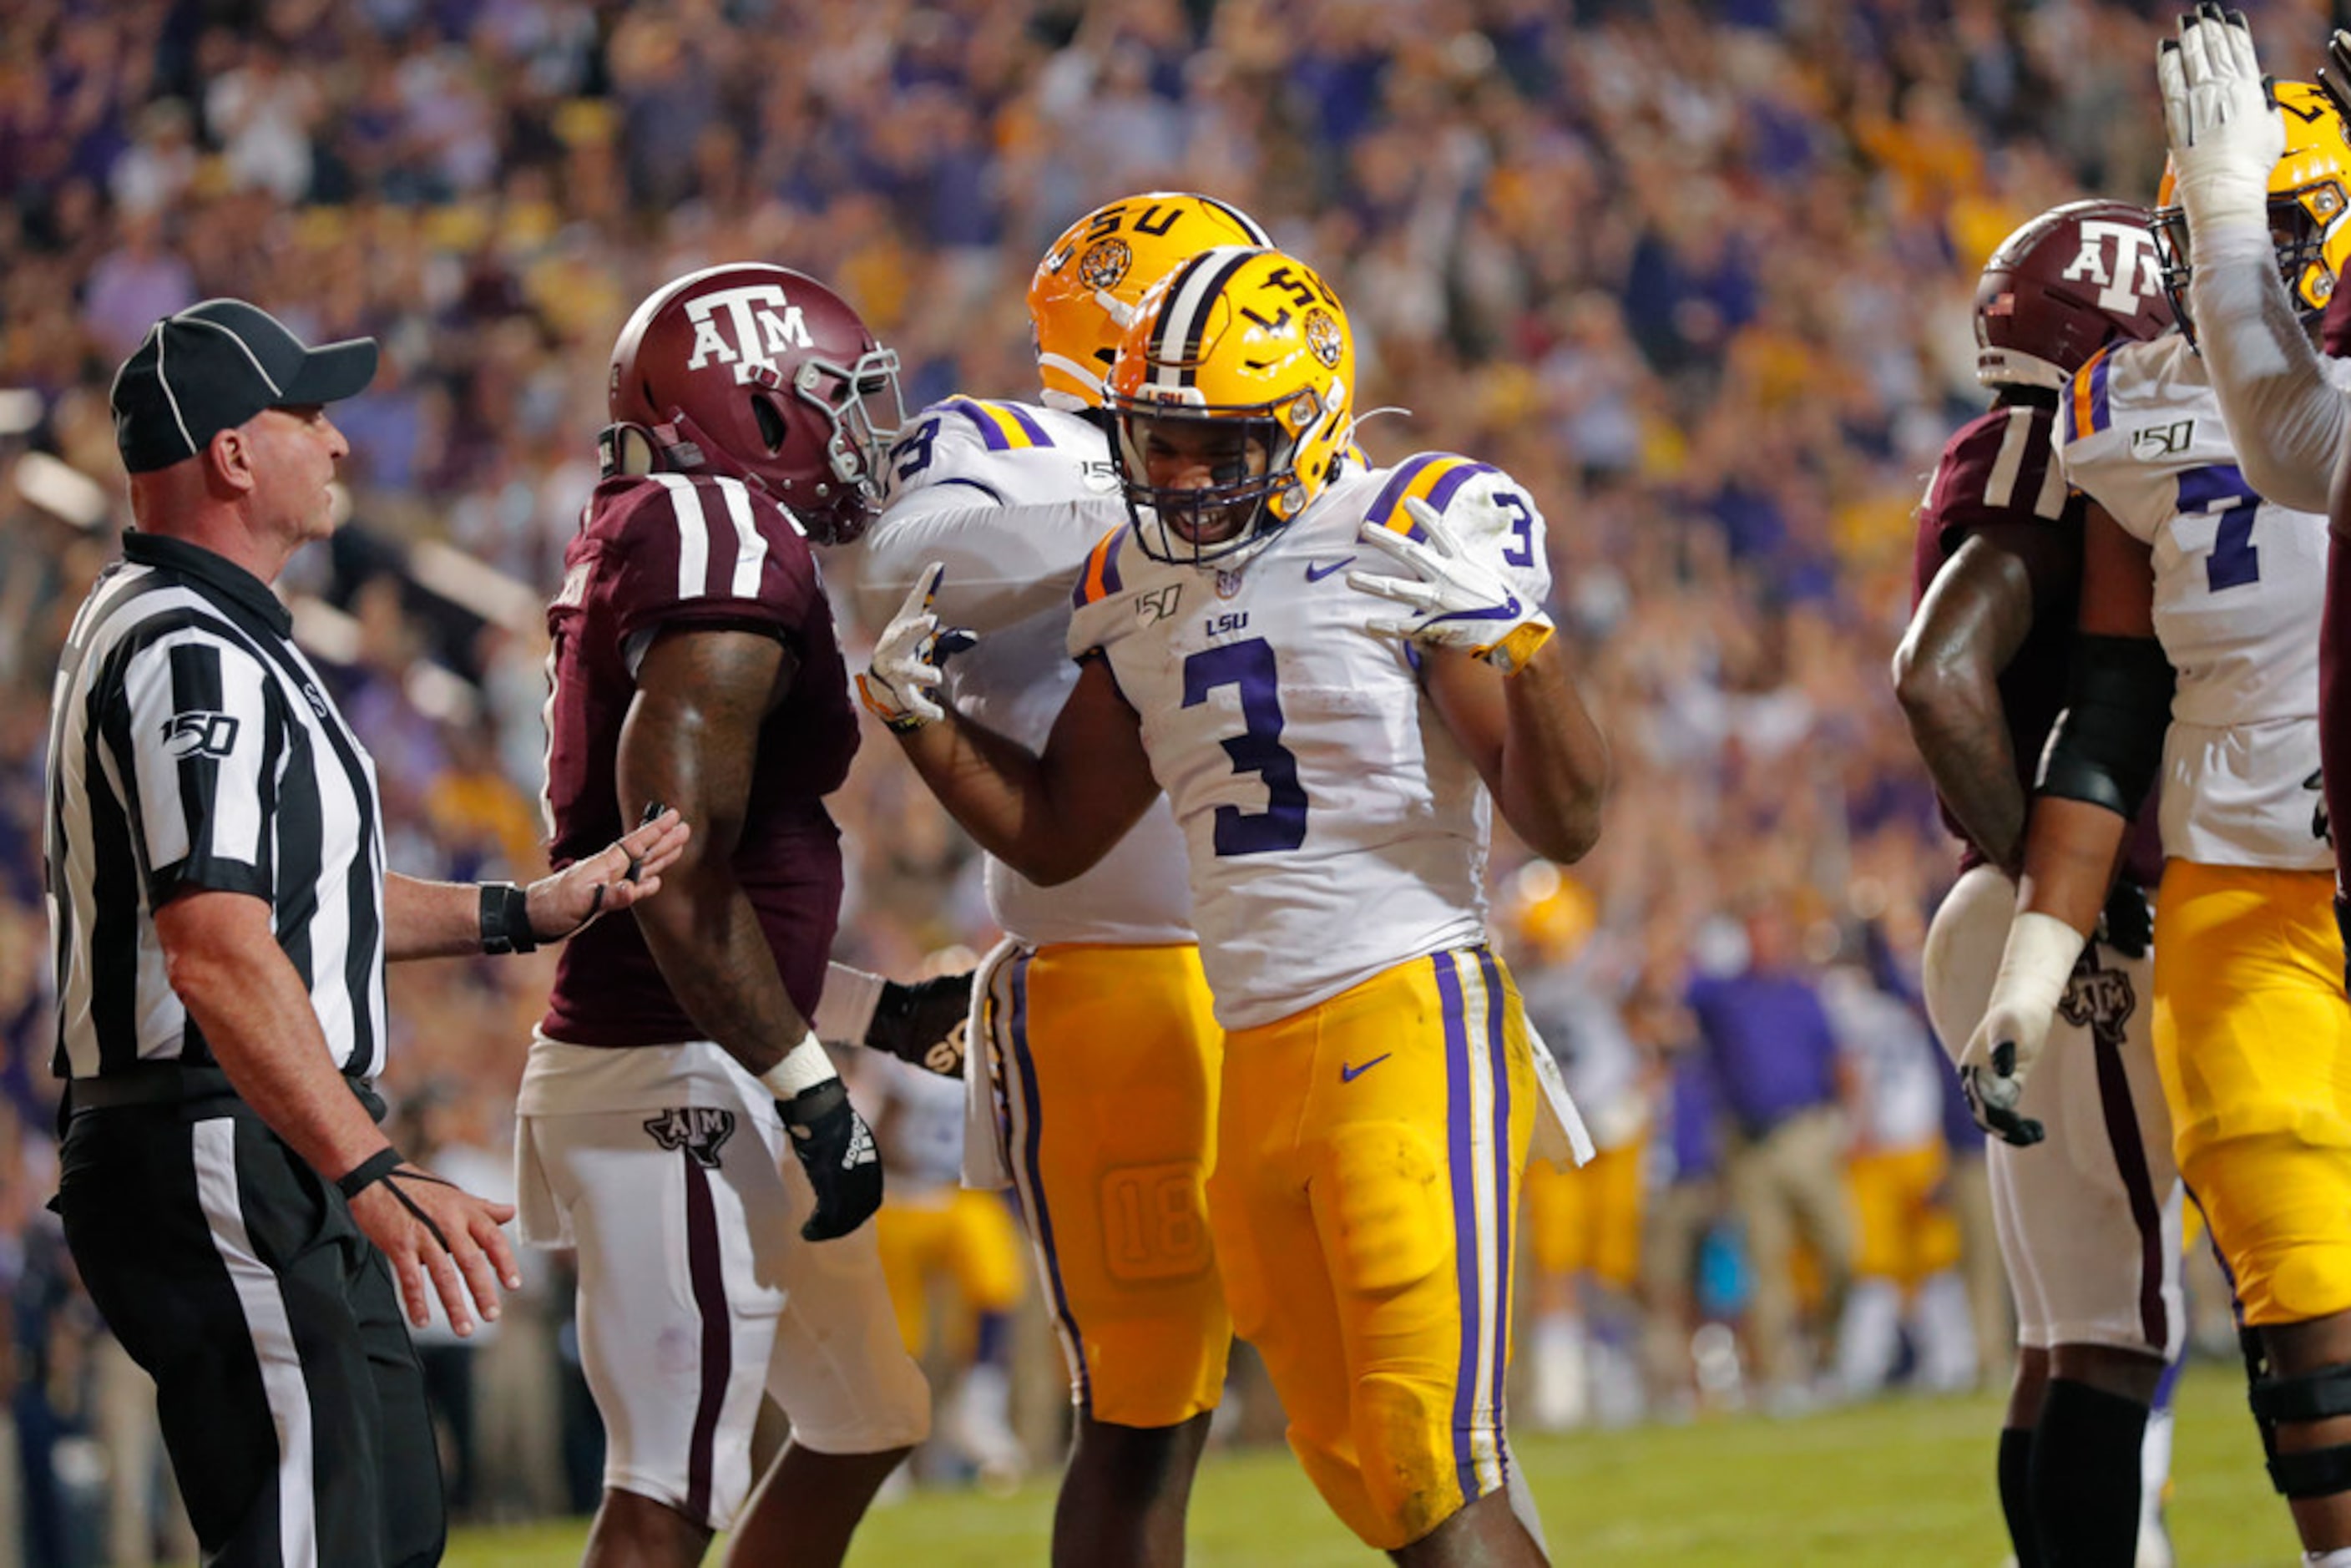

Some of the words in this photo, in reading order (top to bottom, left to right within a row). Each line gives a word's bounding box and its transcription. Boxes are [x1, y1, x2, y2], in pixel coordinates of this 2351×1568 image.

[2133, 420, 2194, 459] 150
[1492, 493, 1534, 567] 3
[2177, 465, 2263, 593] 7
[1136, 583, 1182, 628] 150
[1206, 612, 1249, 636] LSU
[160, 714, 240, 756] 150
[1181, 637, 1309, 857] 3
